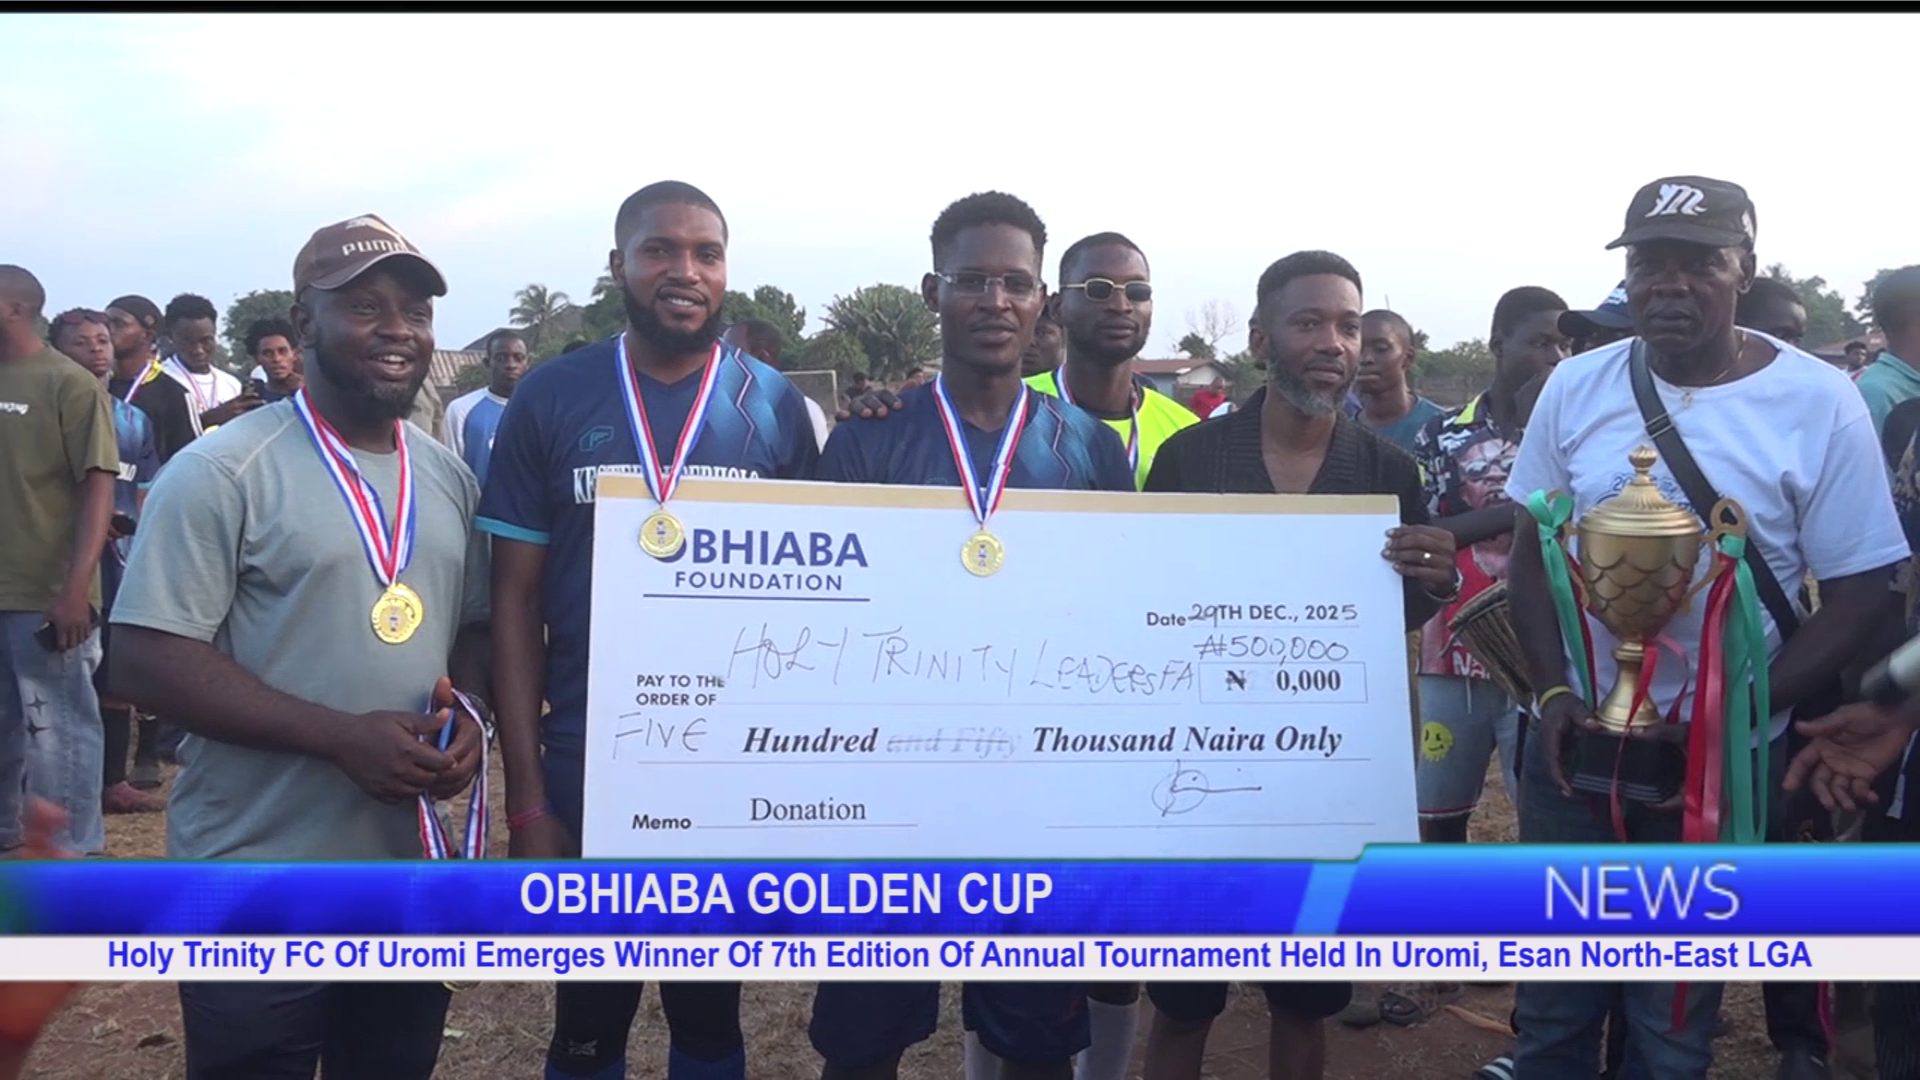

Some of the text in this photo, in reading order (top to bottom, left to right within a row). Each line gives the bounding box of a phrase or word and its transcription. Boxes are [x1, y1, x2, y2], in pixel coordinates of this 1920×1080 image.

[648, 528, 869, 568] BHIABA
[675, 571, 844, 593] FOUNDATION
[1146, 611, 1187, 627] Date
[1305, 603, 1359, 621] 2025
[727, 622, 848, 690] HOLY
[862, 626, 1017, 697] TRINITY
[636, 674, 726, 688] PAY TO THE
[635, 692, 717, 706] ORDER OF
[613, 711, 708, 760] FIVE
[742, 726, 879, 753] Hundred
[1033, 726, 1176, 753] Thousand
[1183, 726, 1265, 753] Naira
[1275, 725, 1343, 758] Only
[750, 797, 867, 821] Donation
[632, 814, 692, 830] Memo
